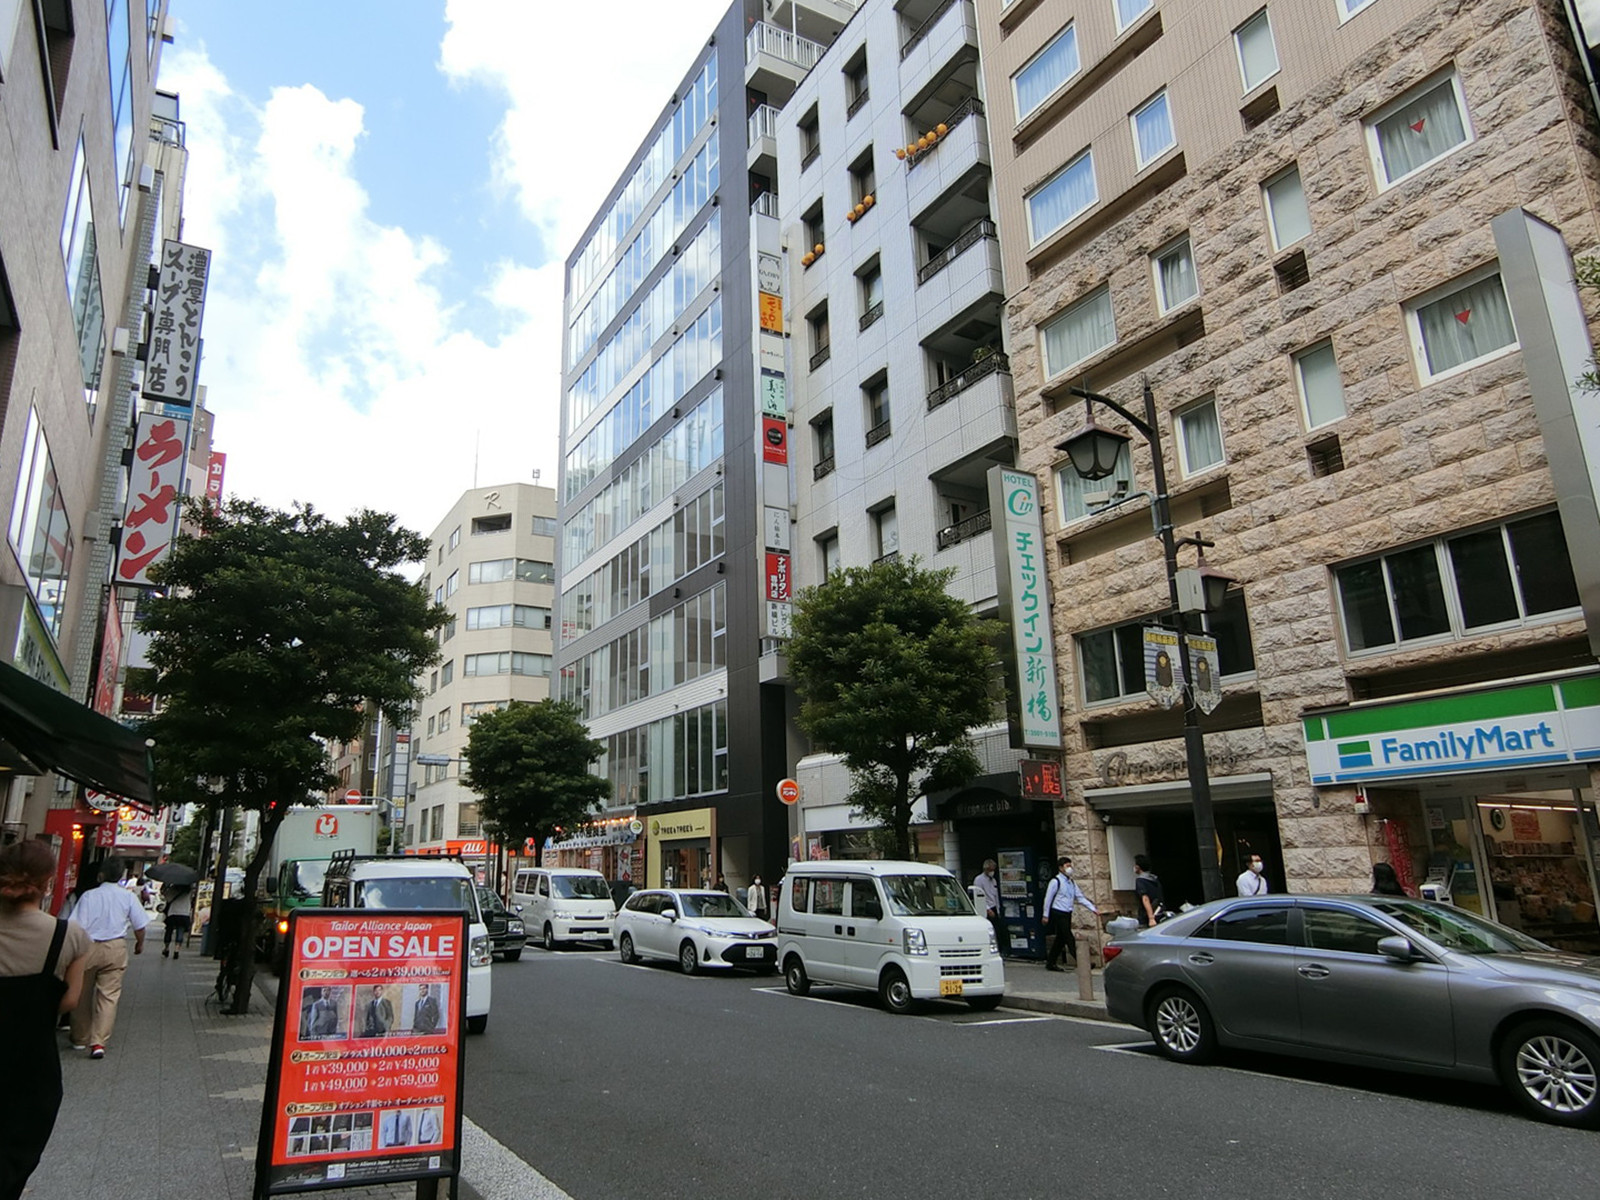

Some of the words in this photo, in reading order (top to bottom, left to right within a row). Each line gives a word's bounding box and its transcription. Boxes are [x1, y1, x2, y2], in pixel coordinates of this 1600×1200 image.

[148, 247, 184, 393] スープ専門店
[175, 250, 207, 398] 濃厚とんこつ
[120, 419, 184, 580] ラーメン
[1003, 473, 1033, 488] HOTEL
[777, 556, 788, 599] ナポリタン
[1015, 531, 1052, 722] チェックイン新橋
[1380, 721, 1555, 765] FamilyMart
[462, 842, 484, 853] au
[301, 935, 381, 959] OPEN
[387, 935, 455, 957] SALE
[331, 920, 358, 931] Tailor
[360, 920, 401, 931] Alliance
[403, 920, 432, 933] Japan
